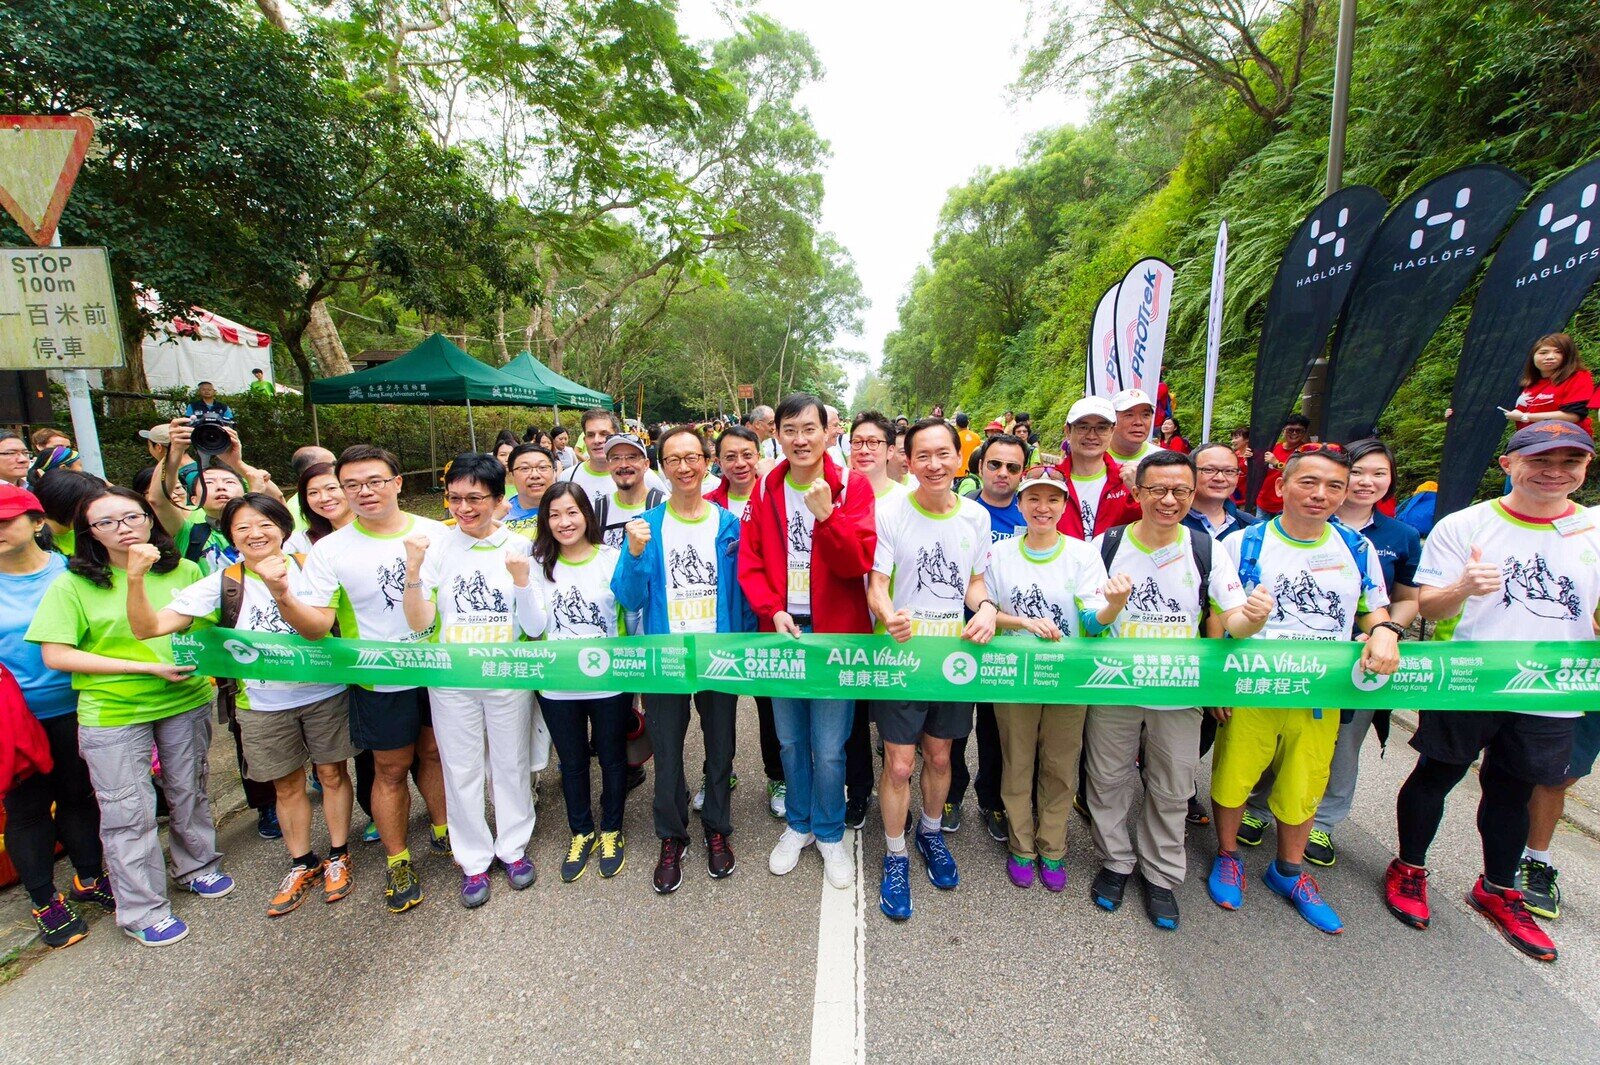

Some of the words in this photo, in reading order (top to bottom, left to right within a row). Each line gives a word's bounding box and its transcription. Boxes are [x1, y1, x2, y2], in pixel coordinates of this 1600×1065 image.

[12, 256, 72, 274] STOP
[1393, 246, 1476, 272] HAGLÖFS
[1516, 247, 1600, 288] HAGLÖFS
[1296, 262, 1352, 288] HAGLÖFS
[18, 277, 76, 293] 100m
[0, 303, 106, 326] 一百米前
[33, 336, 86, 360] 停車
[391, 650, 452, 662] OXFAM
[468, 648, 508, 658] AIA
[508, 648, 556, 664] Vitality
[826, 648, 870, 666] AIA
[872, 646, 922, 672] Vitality
[982, 652, 1018, 665] 樂施會
[310, 660, 332, 668] Poverty
[395, 660, 452, 670] TRAILWALKER
[481, 660, 545, 680] 健康程式
[612, 659, 646, 670] OXFAM
[744, 658, 806, 672] OXFAM
[1222, 654, 1271, 673] AIA
[1273, 652, 1327, 680] Vitality
[746, 671, 806, 680] TRAILWALKER
[980, 666, 1018, 677] OXFAM
[1132, 665, 1200, 680] OXFAM
[1392, 672, 1434, 683] OXFAM
[838, 670, 907, 688] 健康程式
[980, 678, 998, 686] Hong
[998, 678, 1014, 686] Kong
[1034, 679, 1058, 688] Poverty
[1132, 679, 1200, 688] TRAILWALKER
[1234, 678, 1310, 695] 健康程式
[1390, 684, 1409, 692] Hong
[1410, 684, 1428, 692] Kong
[1448, 684, 1476, 692] Poverty
